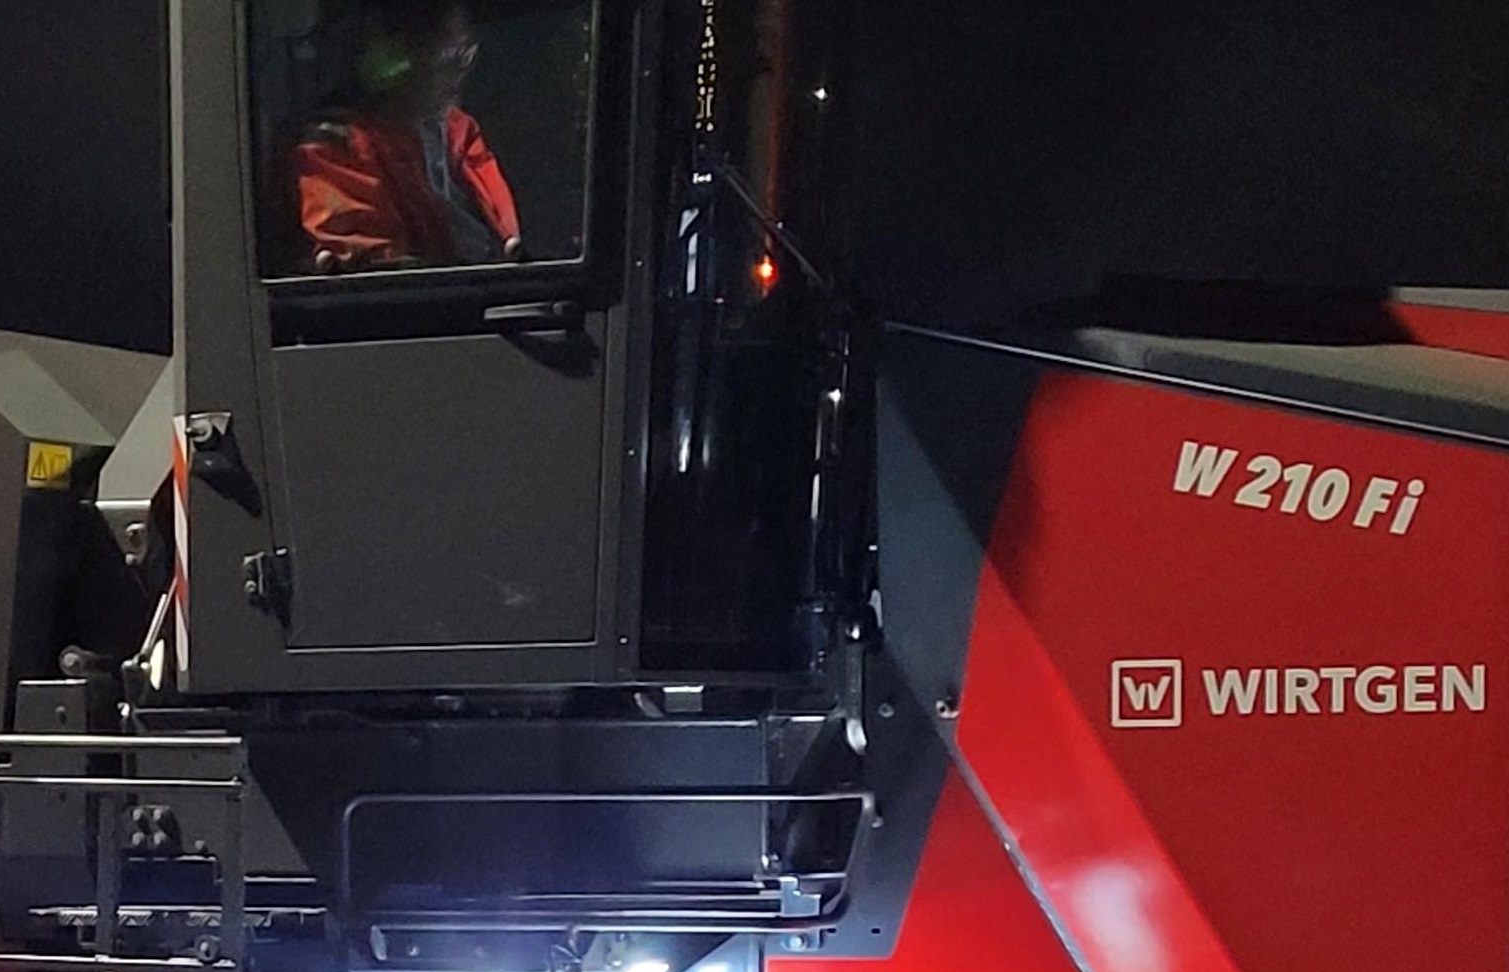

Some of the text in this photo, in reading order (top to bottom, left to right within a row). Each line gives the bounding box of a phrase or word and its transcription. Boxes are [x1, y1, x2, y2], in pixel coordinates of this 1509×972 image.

[1173, 441, 1425, 534] W 210 Fi
[1202, 665, 1485, 715] WIRTGEN
